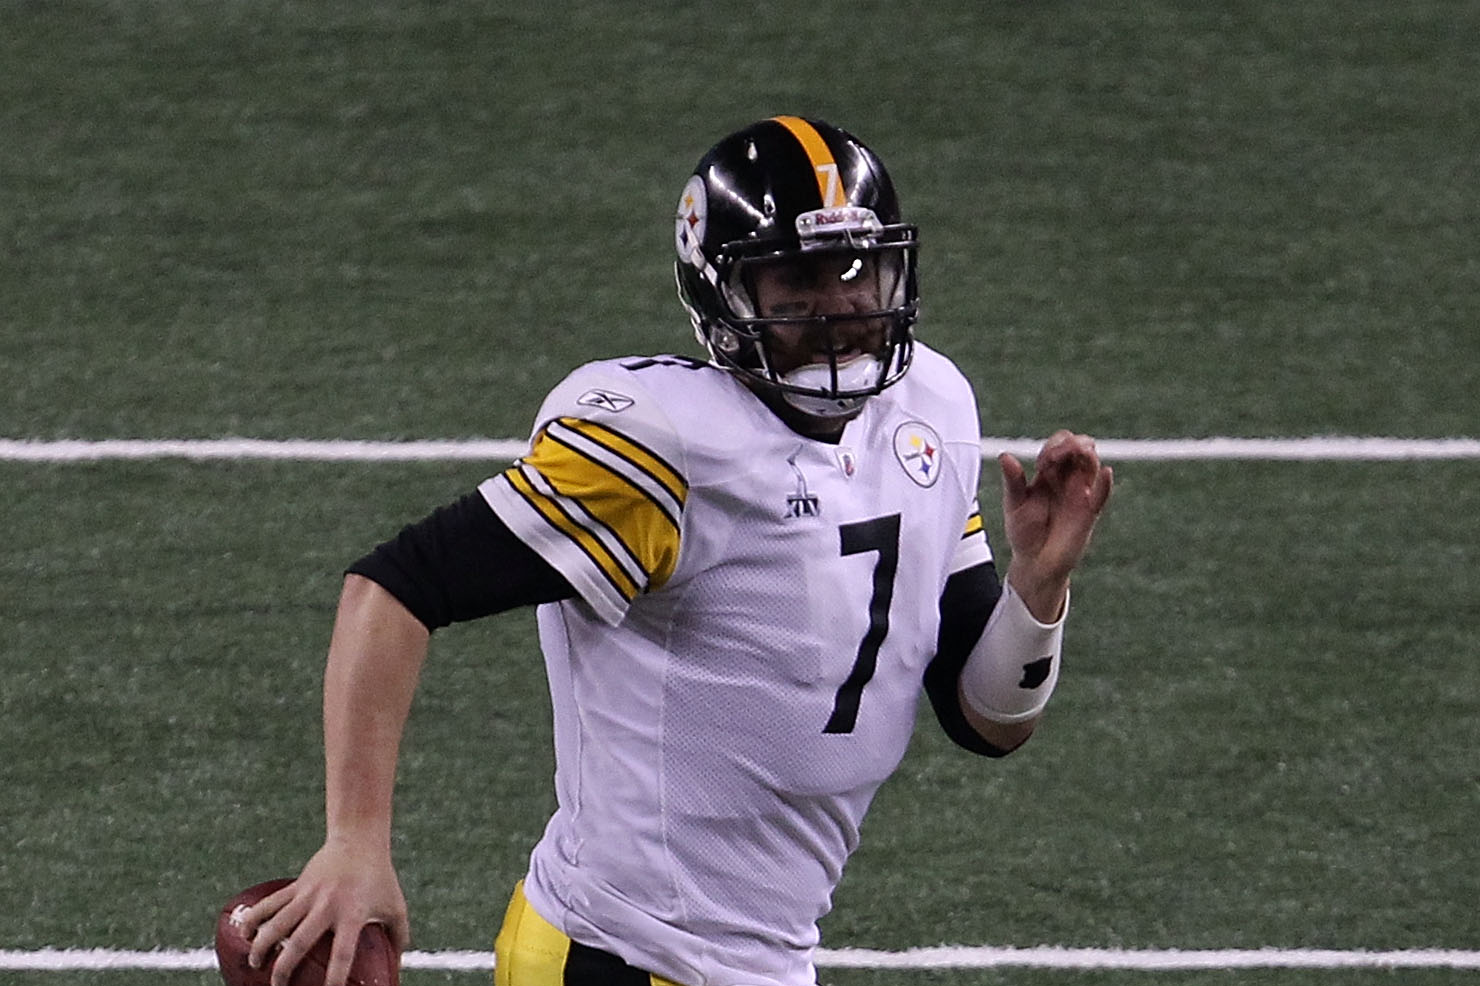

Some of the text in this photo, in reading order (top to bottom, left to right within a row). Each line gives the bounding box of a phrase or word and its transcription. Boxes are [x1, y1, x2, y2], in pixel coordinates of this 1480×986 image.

[815, 162, 838, 208] 7
[815, 210, 858, 225] Riddll
[783, 496, 821, 519] XLV
[821, 512, 901, 734] 7
